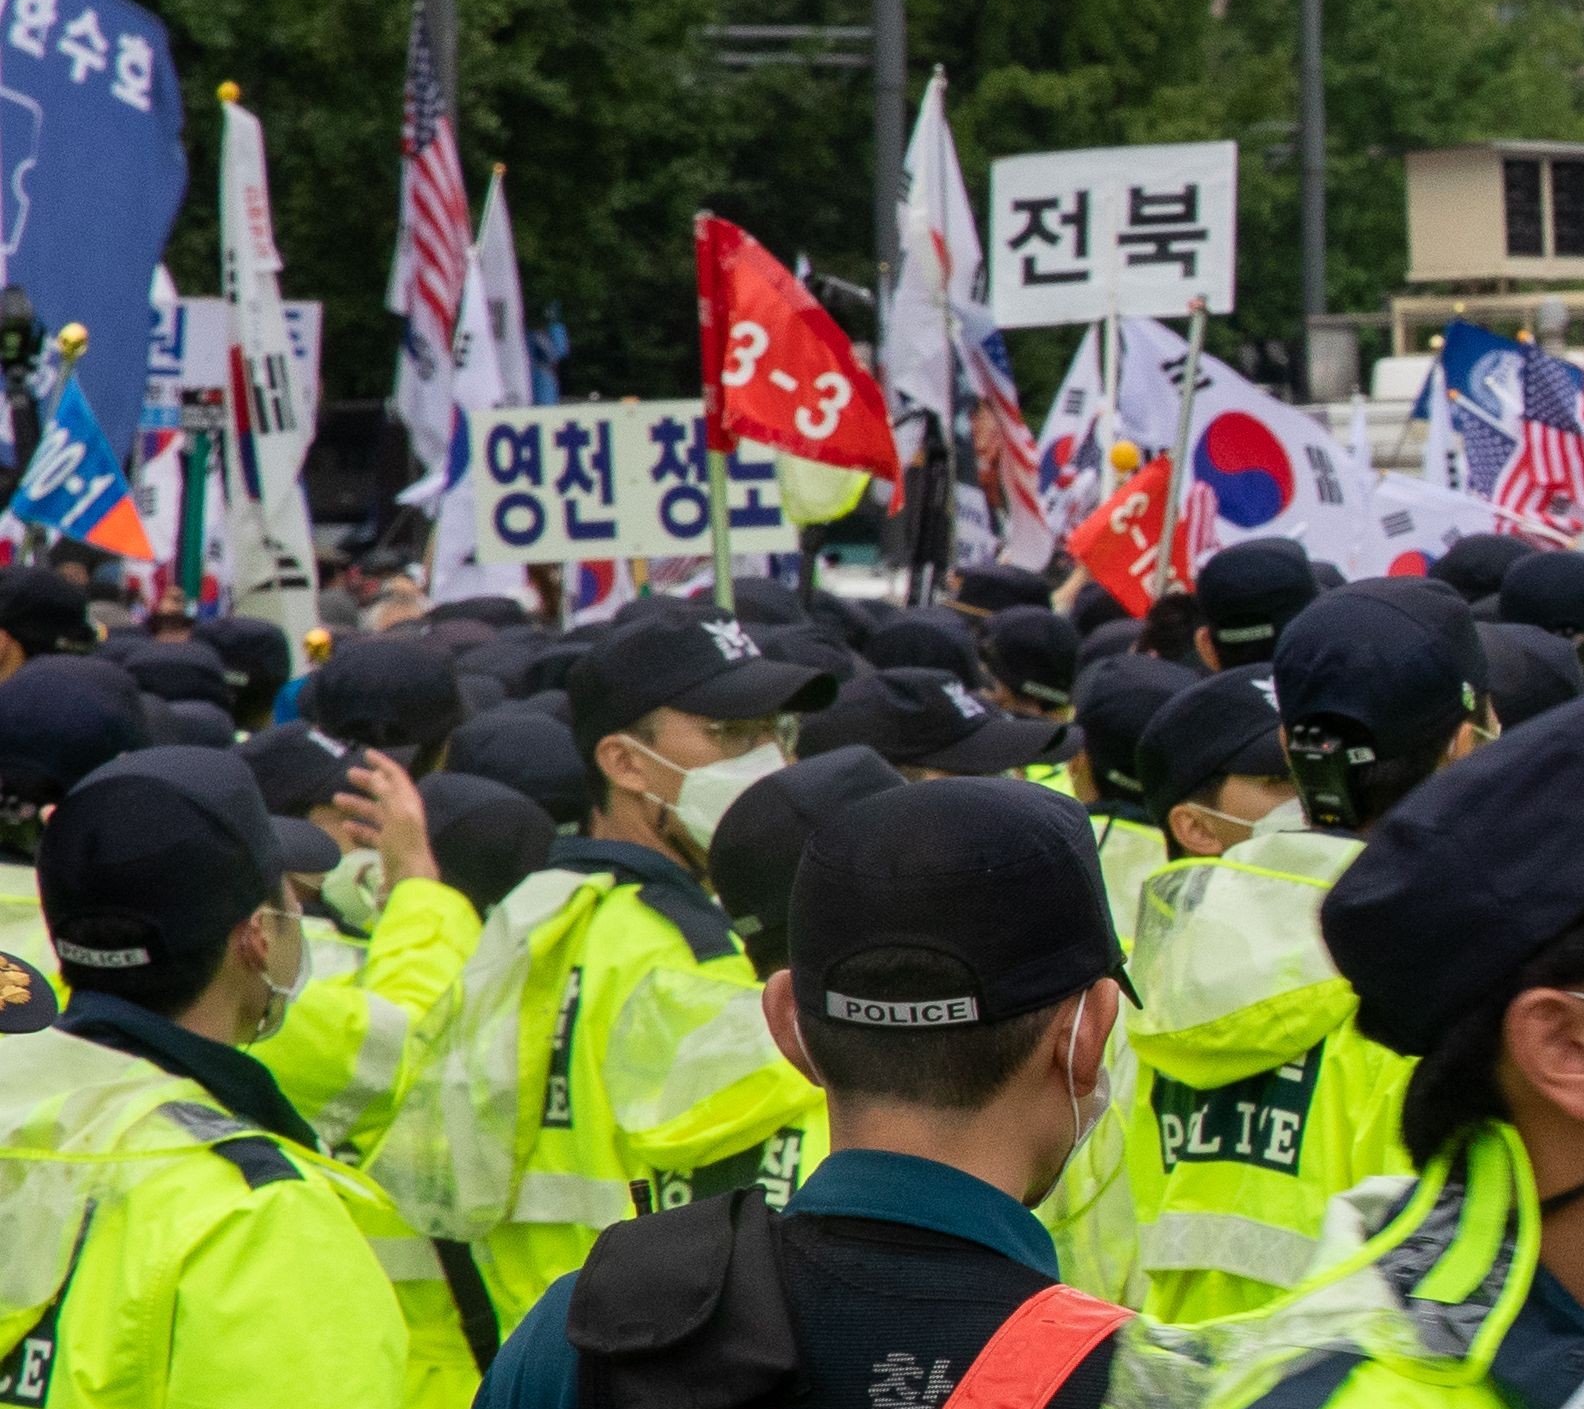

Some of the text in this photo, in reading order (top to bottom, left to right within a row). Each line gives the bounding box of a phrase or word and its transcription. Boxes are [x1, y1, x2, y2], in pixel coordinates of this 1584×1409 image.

[1005, 182, 1210, 288] 전북
[720, 322, 854, 442] 3-3
[485, 420, 618, 549] 영천
[844, 996, 969, 1025] POLICE
